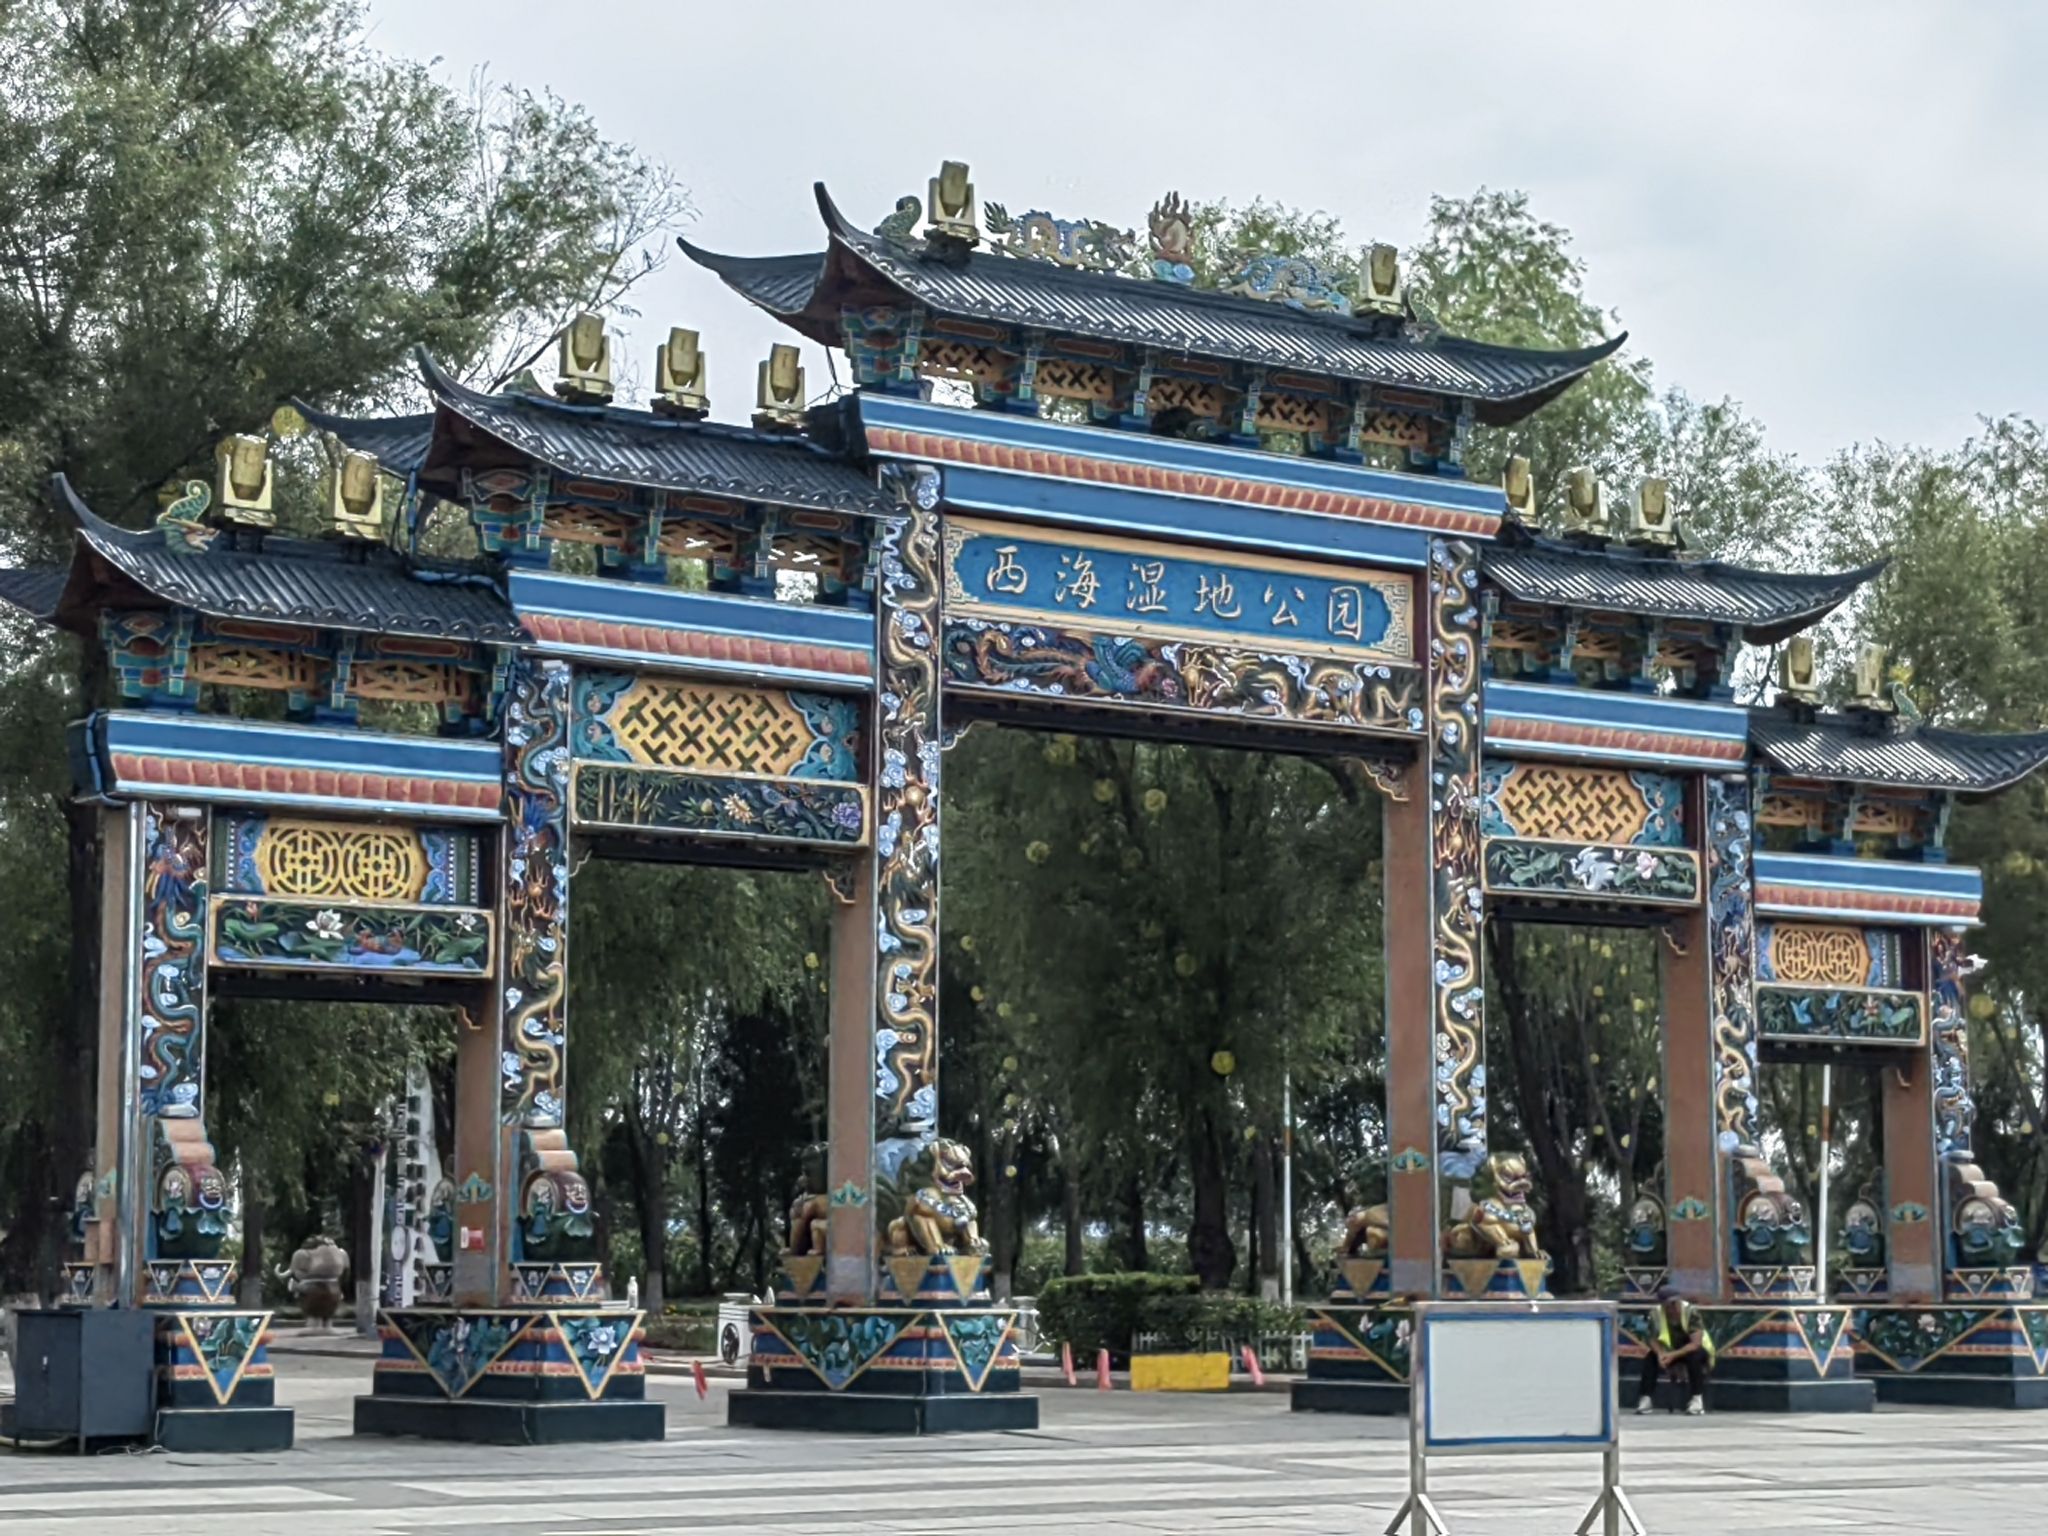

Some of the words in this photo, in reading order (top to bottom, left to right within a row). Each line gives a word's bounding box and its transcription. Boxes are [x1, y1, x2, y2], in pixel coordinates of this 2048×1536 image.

[986, 545, 1363, 640] 西海湿地公园
